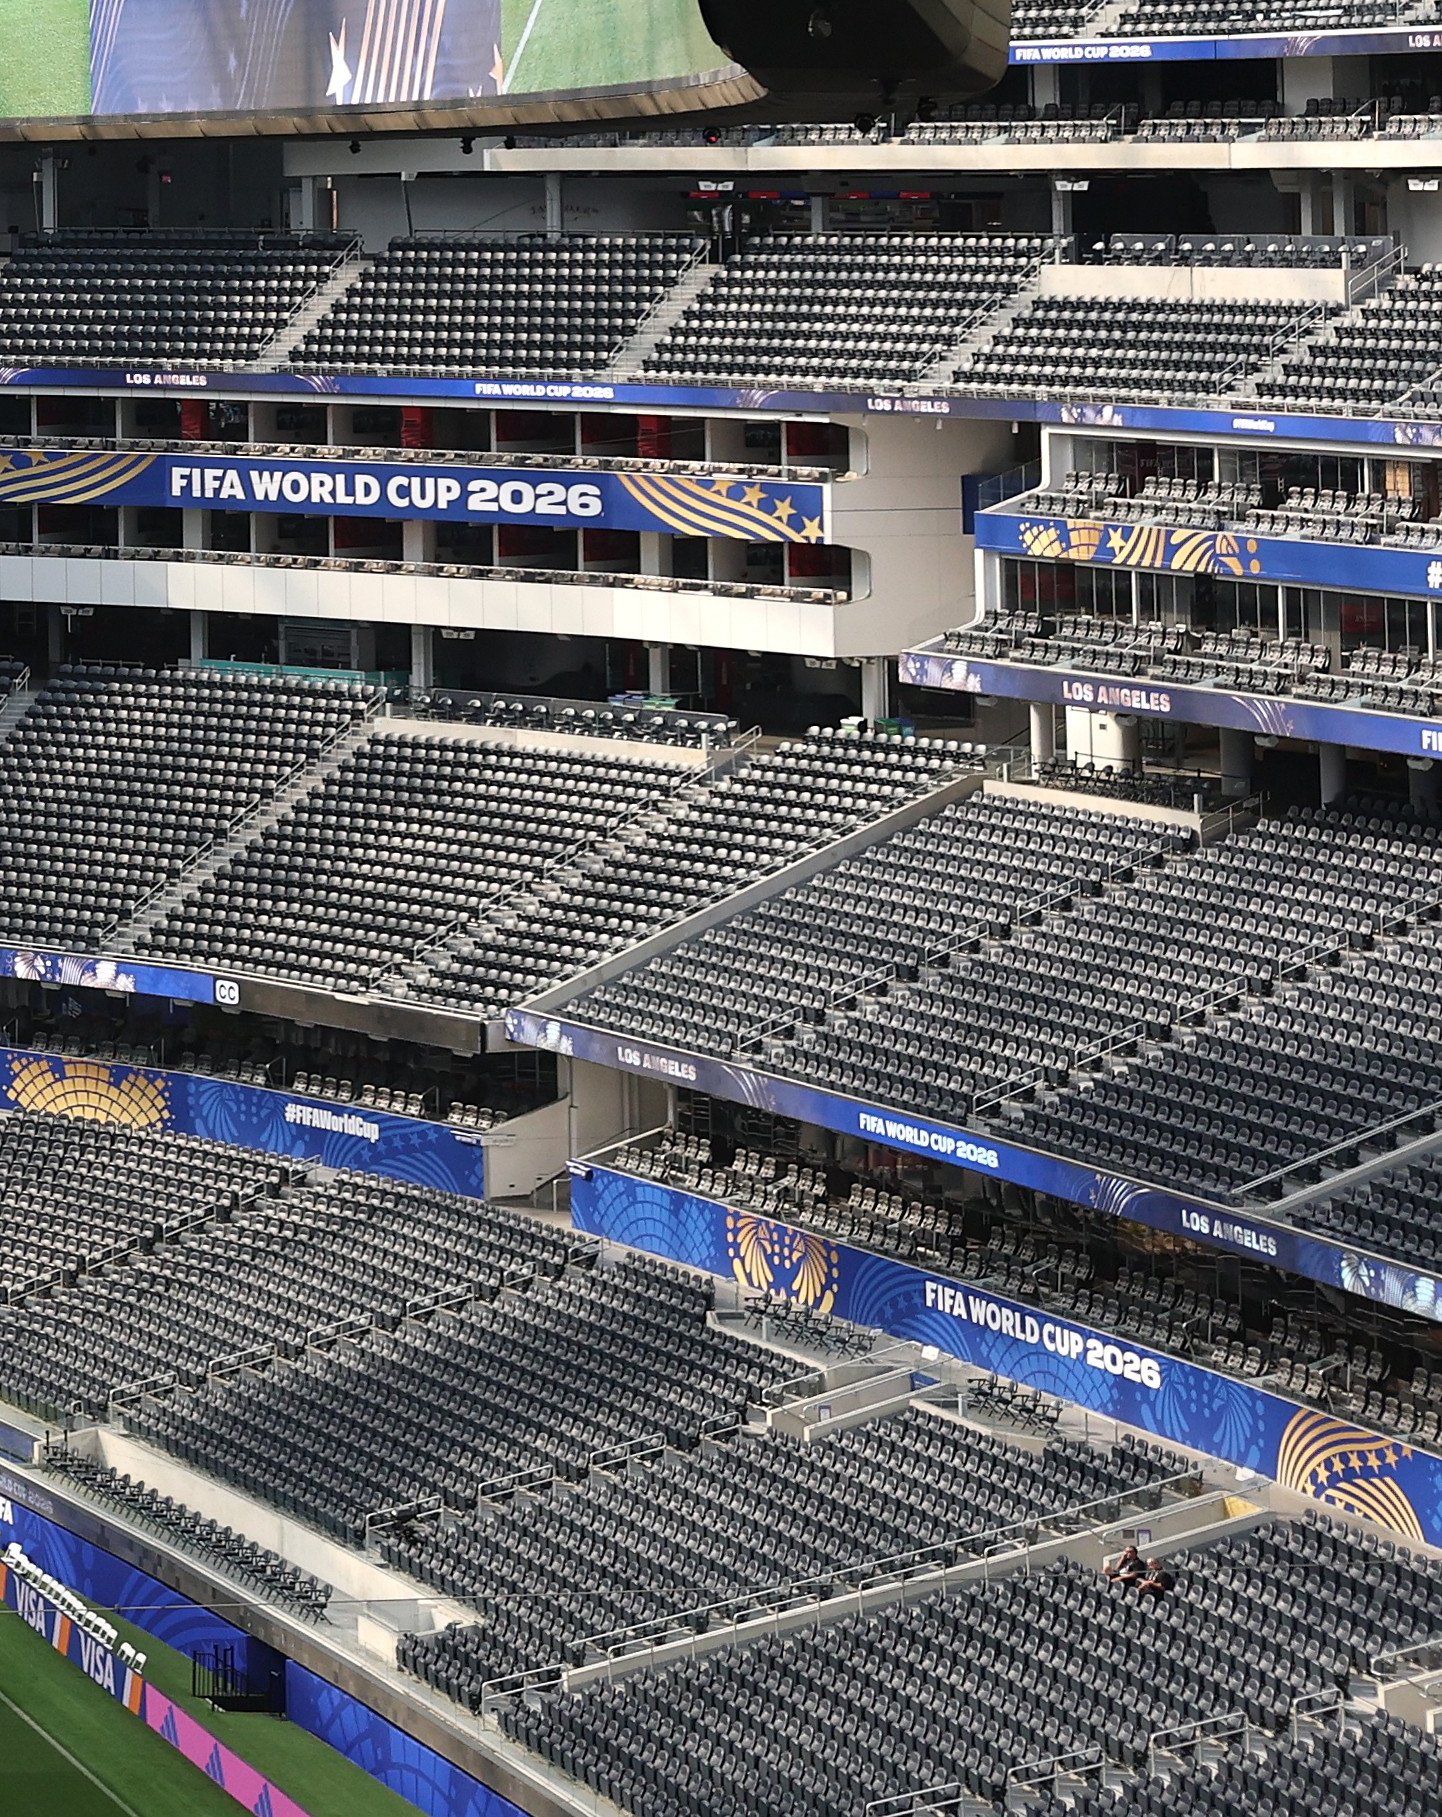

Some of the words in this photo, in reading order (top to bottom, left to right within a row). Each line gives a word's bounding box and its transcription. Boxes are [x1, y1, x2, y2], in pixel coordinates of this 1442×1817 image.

[1015, 47, 1039, 61] FIFA
[1084, 45, 1108, 60] CUP
[171, 466, 246, 500] FIFA
[249, 470, 381, 505] WORLD
[386, 475, 461, 509] CUP
[467, 479, 602, 517] 2026
[1062, 680, 1095, 702] LOS
[1097, 684, 1171, 713] ANGELES
[219, 984, 236, 1001] CC
[617, 1046, 641, 1066] LOS
[642, 1053, 697, 1081] ANGELES
[284, 1102, 380, 1144] #FIFAWorldCup
[859, 1112, 885, 1136] FIFA
[885, 1119, 930, 1147] WORLD
[929, 1132, 956, 1155] CUP
[955, 1140, 999, 1168] 2026
[1181, 1209, 1210, 1234] LOS
[1212, 1219, 1277, 1256] ANGELES
[925, 1280, 968, 1320] FIFA
[968, 1295, 1040, 1344] WORLD
[1042, 1322, 1084, 1360] CUP
[1085, 1338, 1161, 1390] 2026
[13, 1575, 47, 1637] VISA
[79, 1635, 115, 1696] VISA
